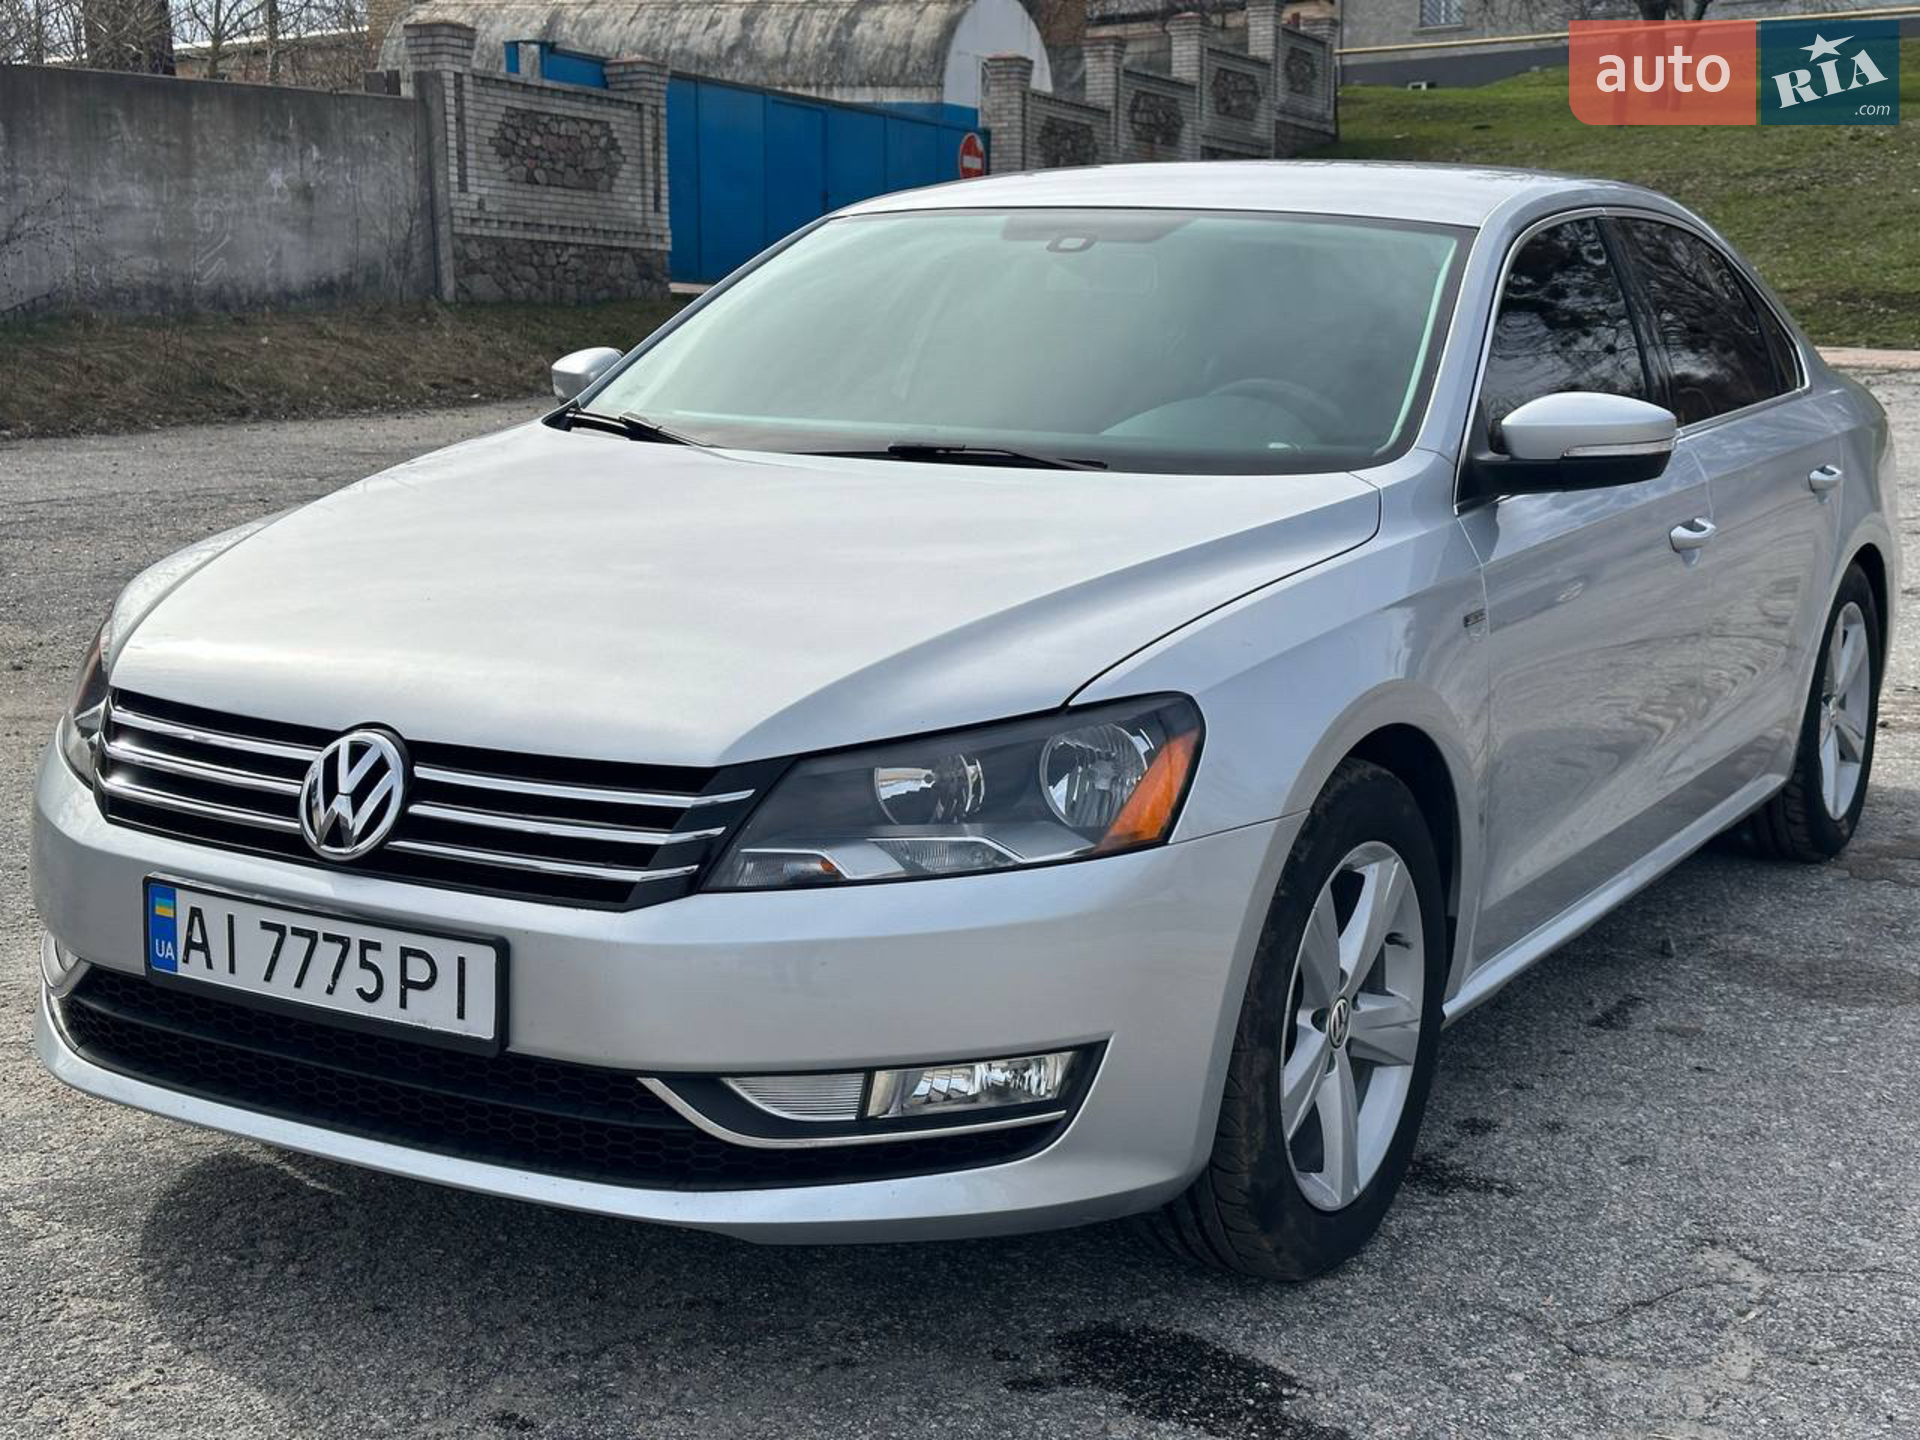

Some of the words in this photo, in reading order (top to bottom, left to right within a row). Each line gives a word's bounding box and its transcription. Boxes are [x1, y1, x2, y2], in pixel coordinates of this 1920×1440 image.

[303, 732, 402, 856] VW
[155, 938, 176, 961] UA
[181, 906, 236, 975] AI
[259, 920, 384, 1003] 7775
[399, 945, 466, 1020] PI
